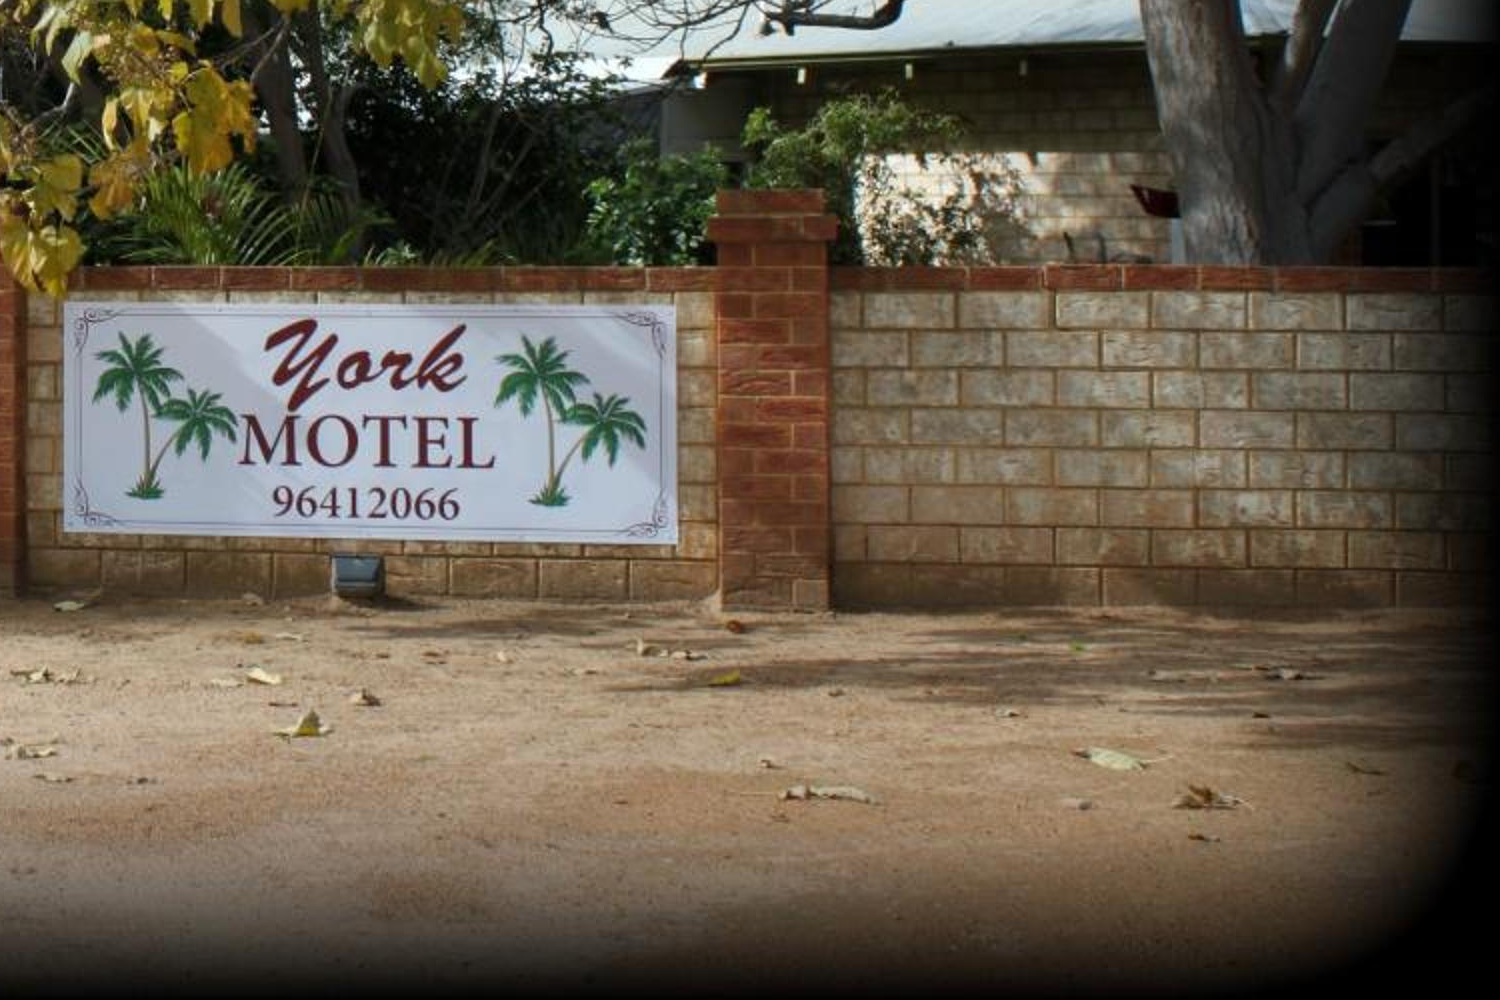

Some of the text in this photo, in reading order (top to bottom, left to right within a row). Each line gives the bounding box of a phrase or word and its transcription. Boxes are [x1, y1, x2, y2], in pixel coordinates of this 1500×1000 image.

[264, 318, 467, 412] York
[238, 413, 496, 469] MOTEL
[272, 485, 460, 521] 96412066
